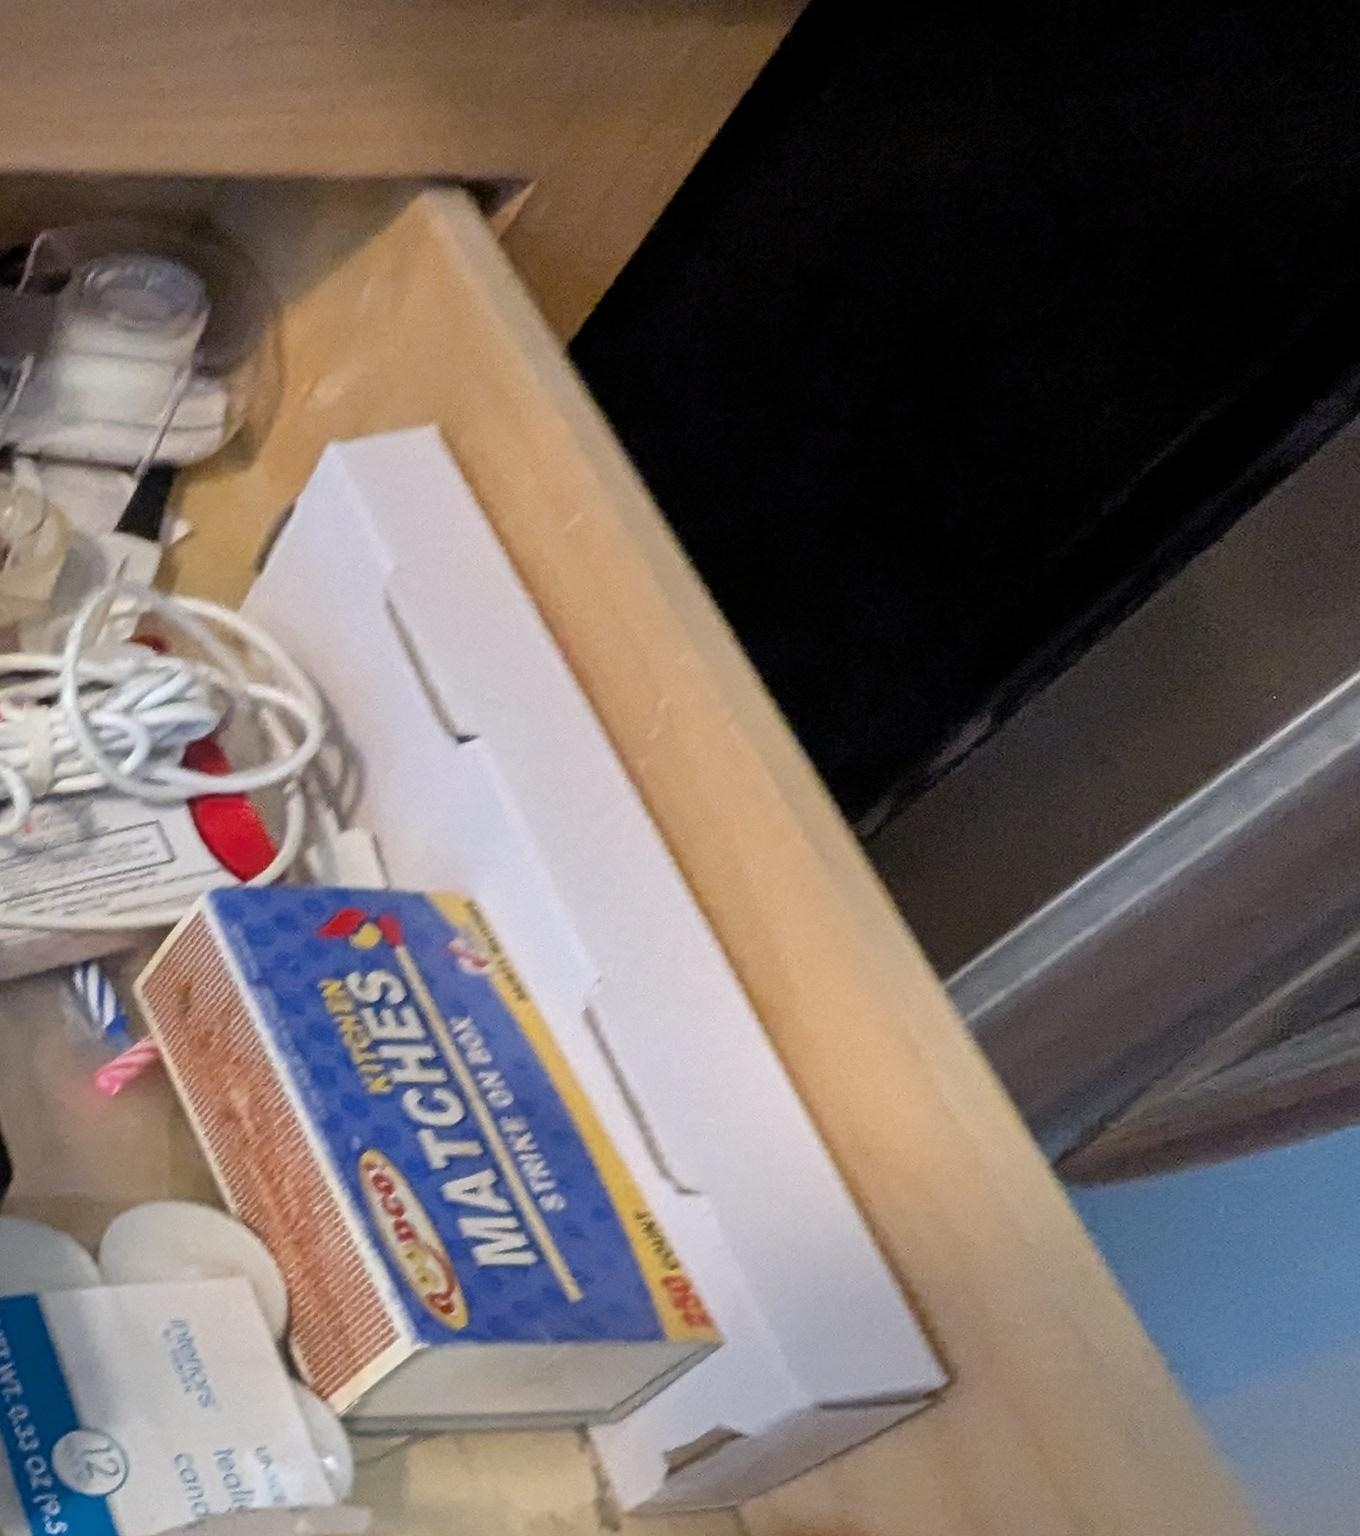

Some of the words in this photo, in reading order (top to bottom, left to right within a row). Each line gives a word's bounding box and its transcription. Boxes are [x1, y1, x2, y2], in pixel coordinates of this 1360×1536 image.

[318, 978, 392, 1094] KITCHEN
[449, 1014, 494, 1060] BOX
[346, 968, 541, 1268] MATCHES
[473, 1069, 516, 1110] ON
[500, 1115, 568, 1213] STRIKE
[7, 1406, 41, 1451] 0.33
[24, 1454, 55, 1490] OZ
[80, 1446, 120, 1481] 12
